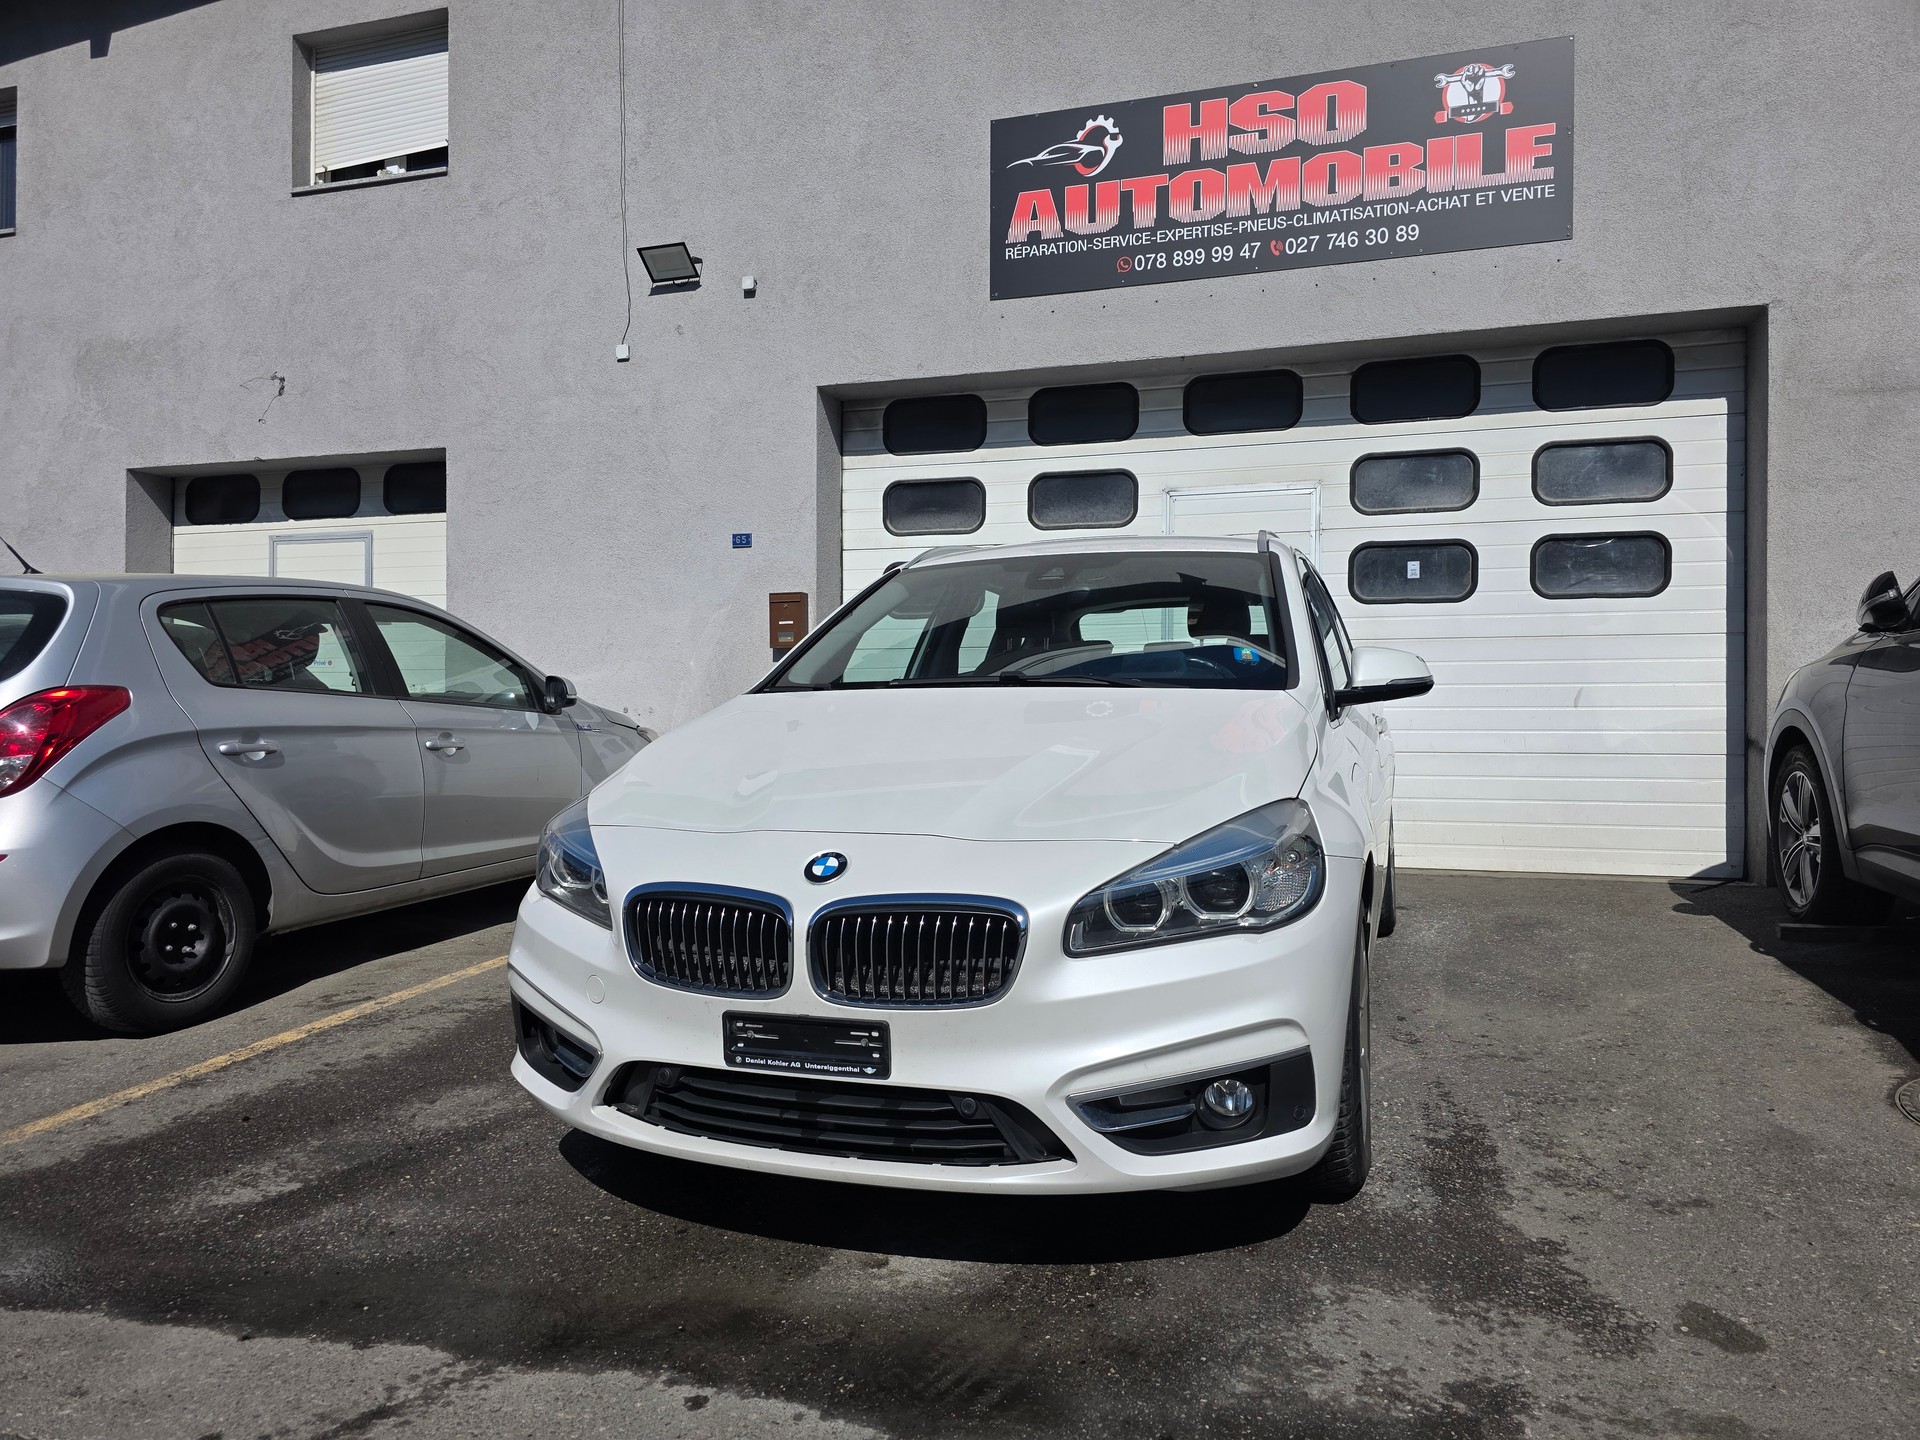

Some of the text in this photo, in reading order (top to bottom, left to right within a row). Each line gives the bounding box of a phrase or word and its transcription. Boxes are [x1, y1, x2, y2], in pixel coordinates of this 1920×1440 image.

[1163, 80, 1368, 166] HSO
[1005, 122, 1555, 244] AUTOMOBILE
[1476, 191, 1496, 206] ET
[1501, 184, 1555, 203] VENTE
[1134, 224, 1420, 271] 078 899 99 47 027 746 30 89
[735, 535, 747, 544] 65
[745, 1057, 766, 1065] Daniel
[767, 1059, 789, 1067] Kohler
[804, 1063, 860, 1073] Untersiggenthal
